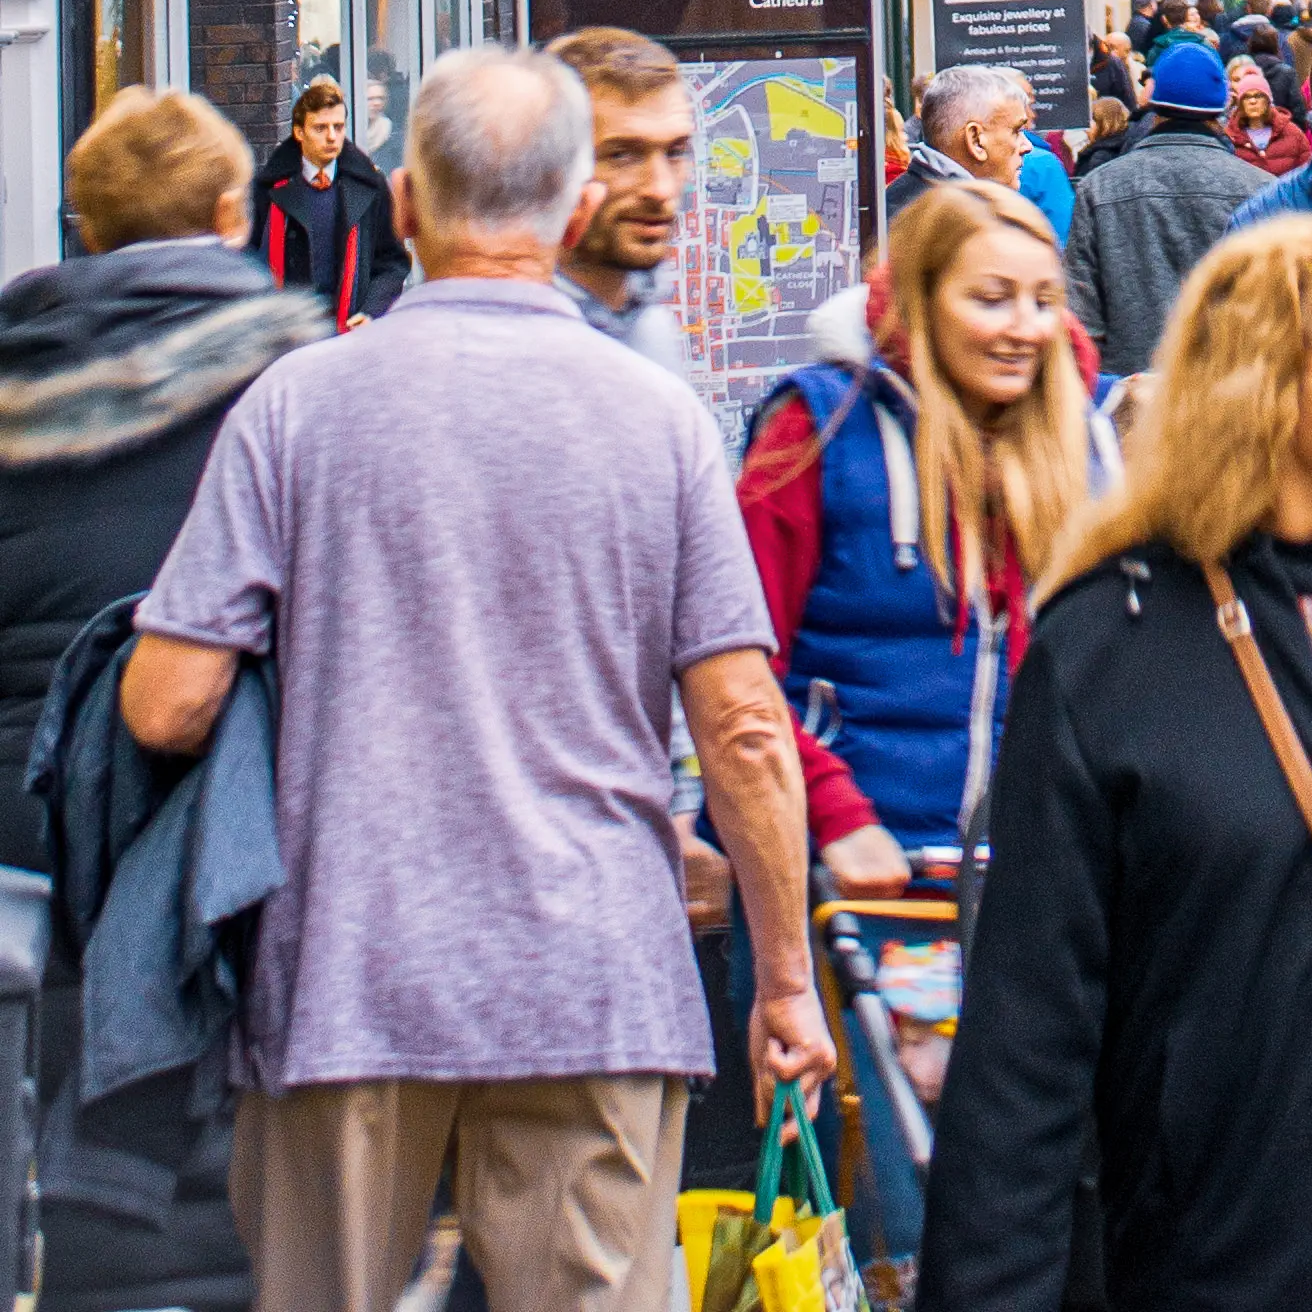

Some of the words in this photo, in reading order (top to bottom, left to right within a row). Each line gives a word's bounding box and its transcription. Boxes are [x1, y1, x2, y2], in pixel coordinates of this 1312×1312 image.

[951, 10, 1002, 25] Exquisite
[1002, 8, 1052, 23] jewellery
[1052, 7, 1066, 19] at
[968, 23, 1016, 37] fabulous
[1016, 20, 1051, 36] prices
